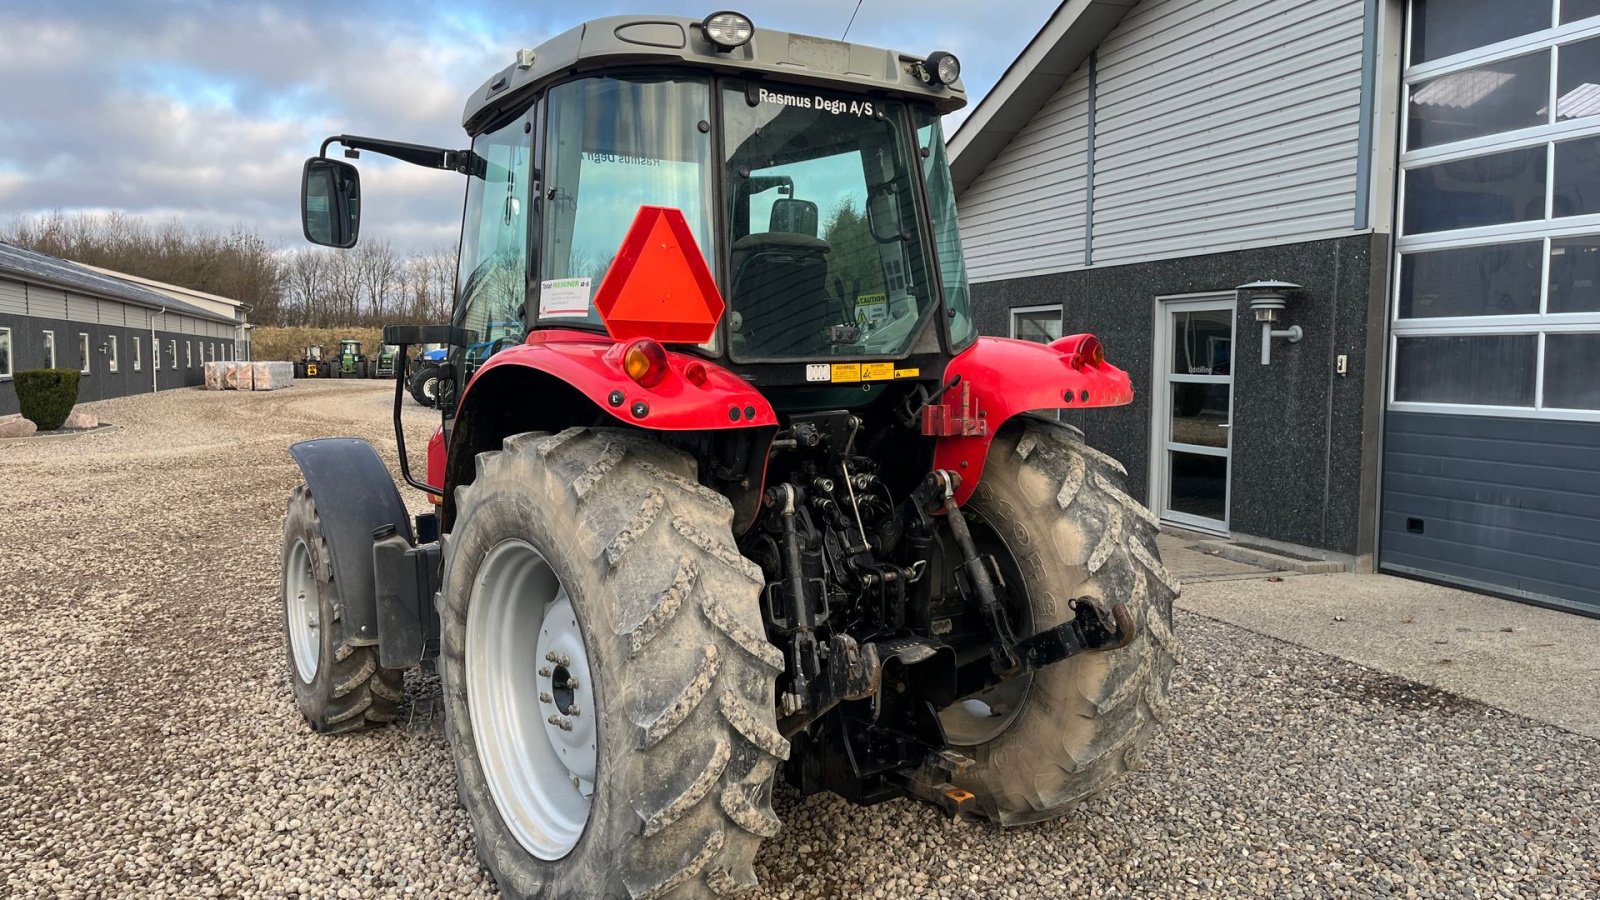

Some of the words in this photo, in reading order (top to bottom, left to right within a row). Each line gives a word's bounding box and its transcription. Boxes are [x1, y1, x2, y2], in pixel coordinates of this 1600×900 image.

[759, 88, 811, 108] Rasmus
[815, 96, 847, 114] Degn
[850, 101, 873, 117] A/S
[860, 295, 885, 304] CAUTION
[1188, 365, 1213, 375] Udstilling
